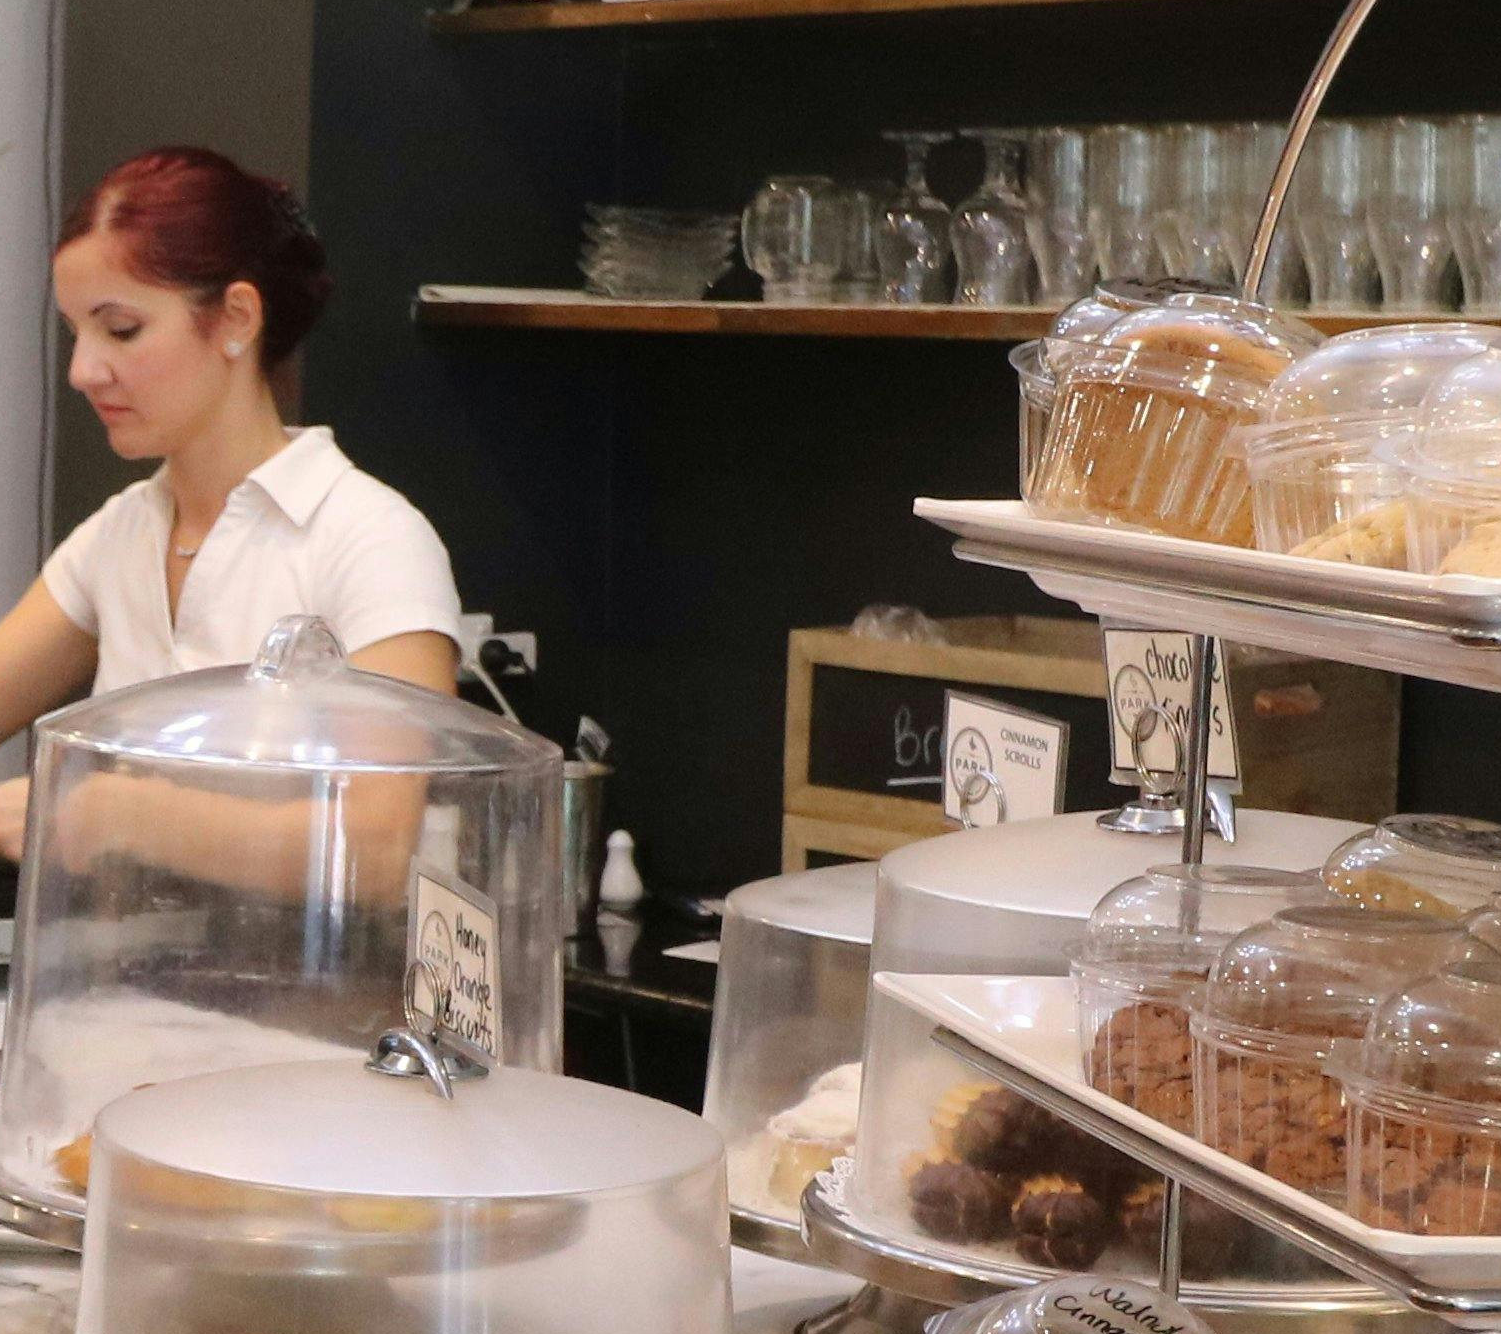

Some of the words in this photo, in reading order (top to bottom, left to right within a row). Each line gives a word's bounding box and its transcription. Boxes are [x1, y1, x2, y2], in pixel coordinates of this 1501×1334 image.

[1146, 637, 1221, 684] chocole
[1000, 728, 1049, 754] CINNAMON
[1004, 749, 1042, 771] SCROLLS
[455, 912, 488, 967] Honey
